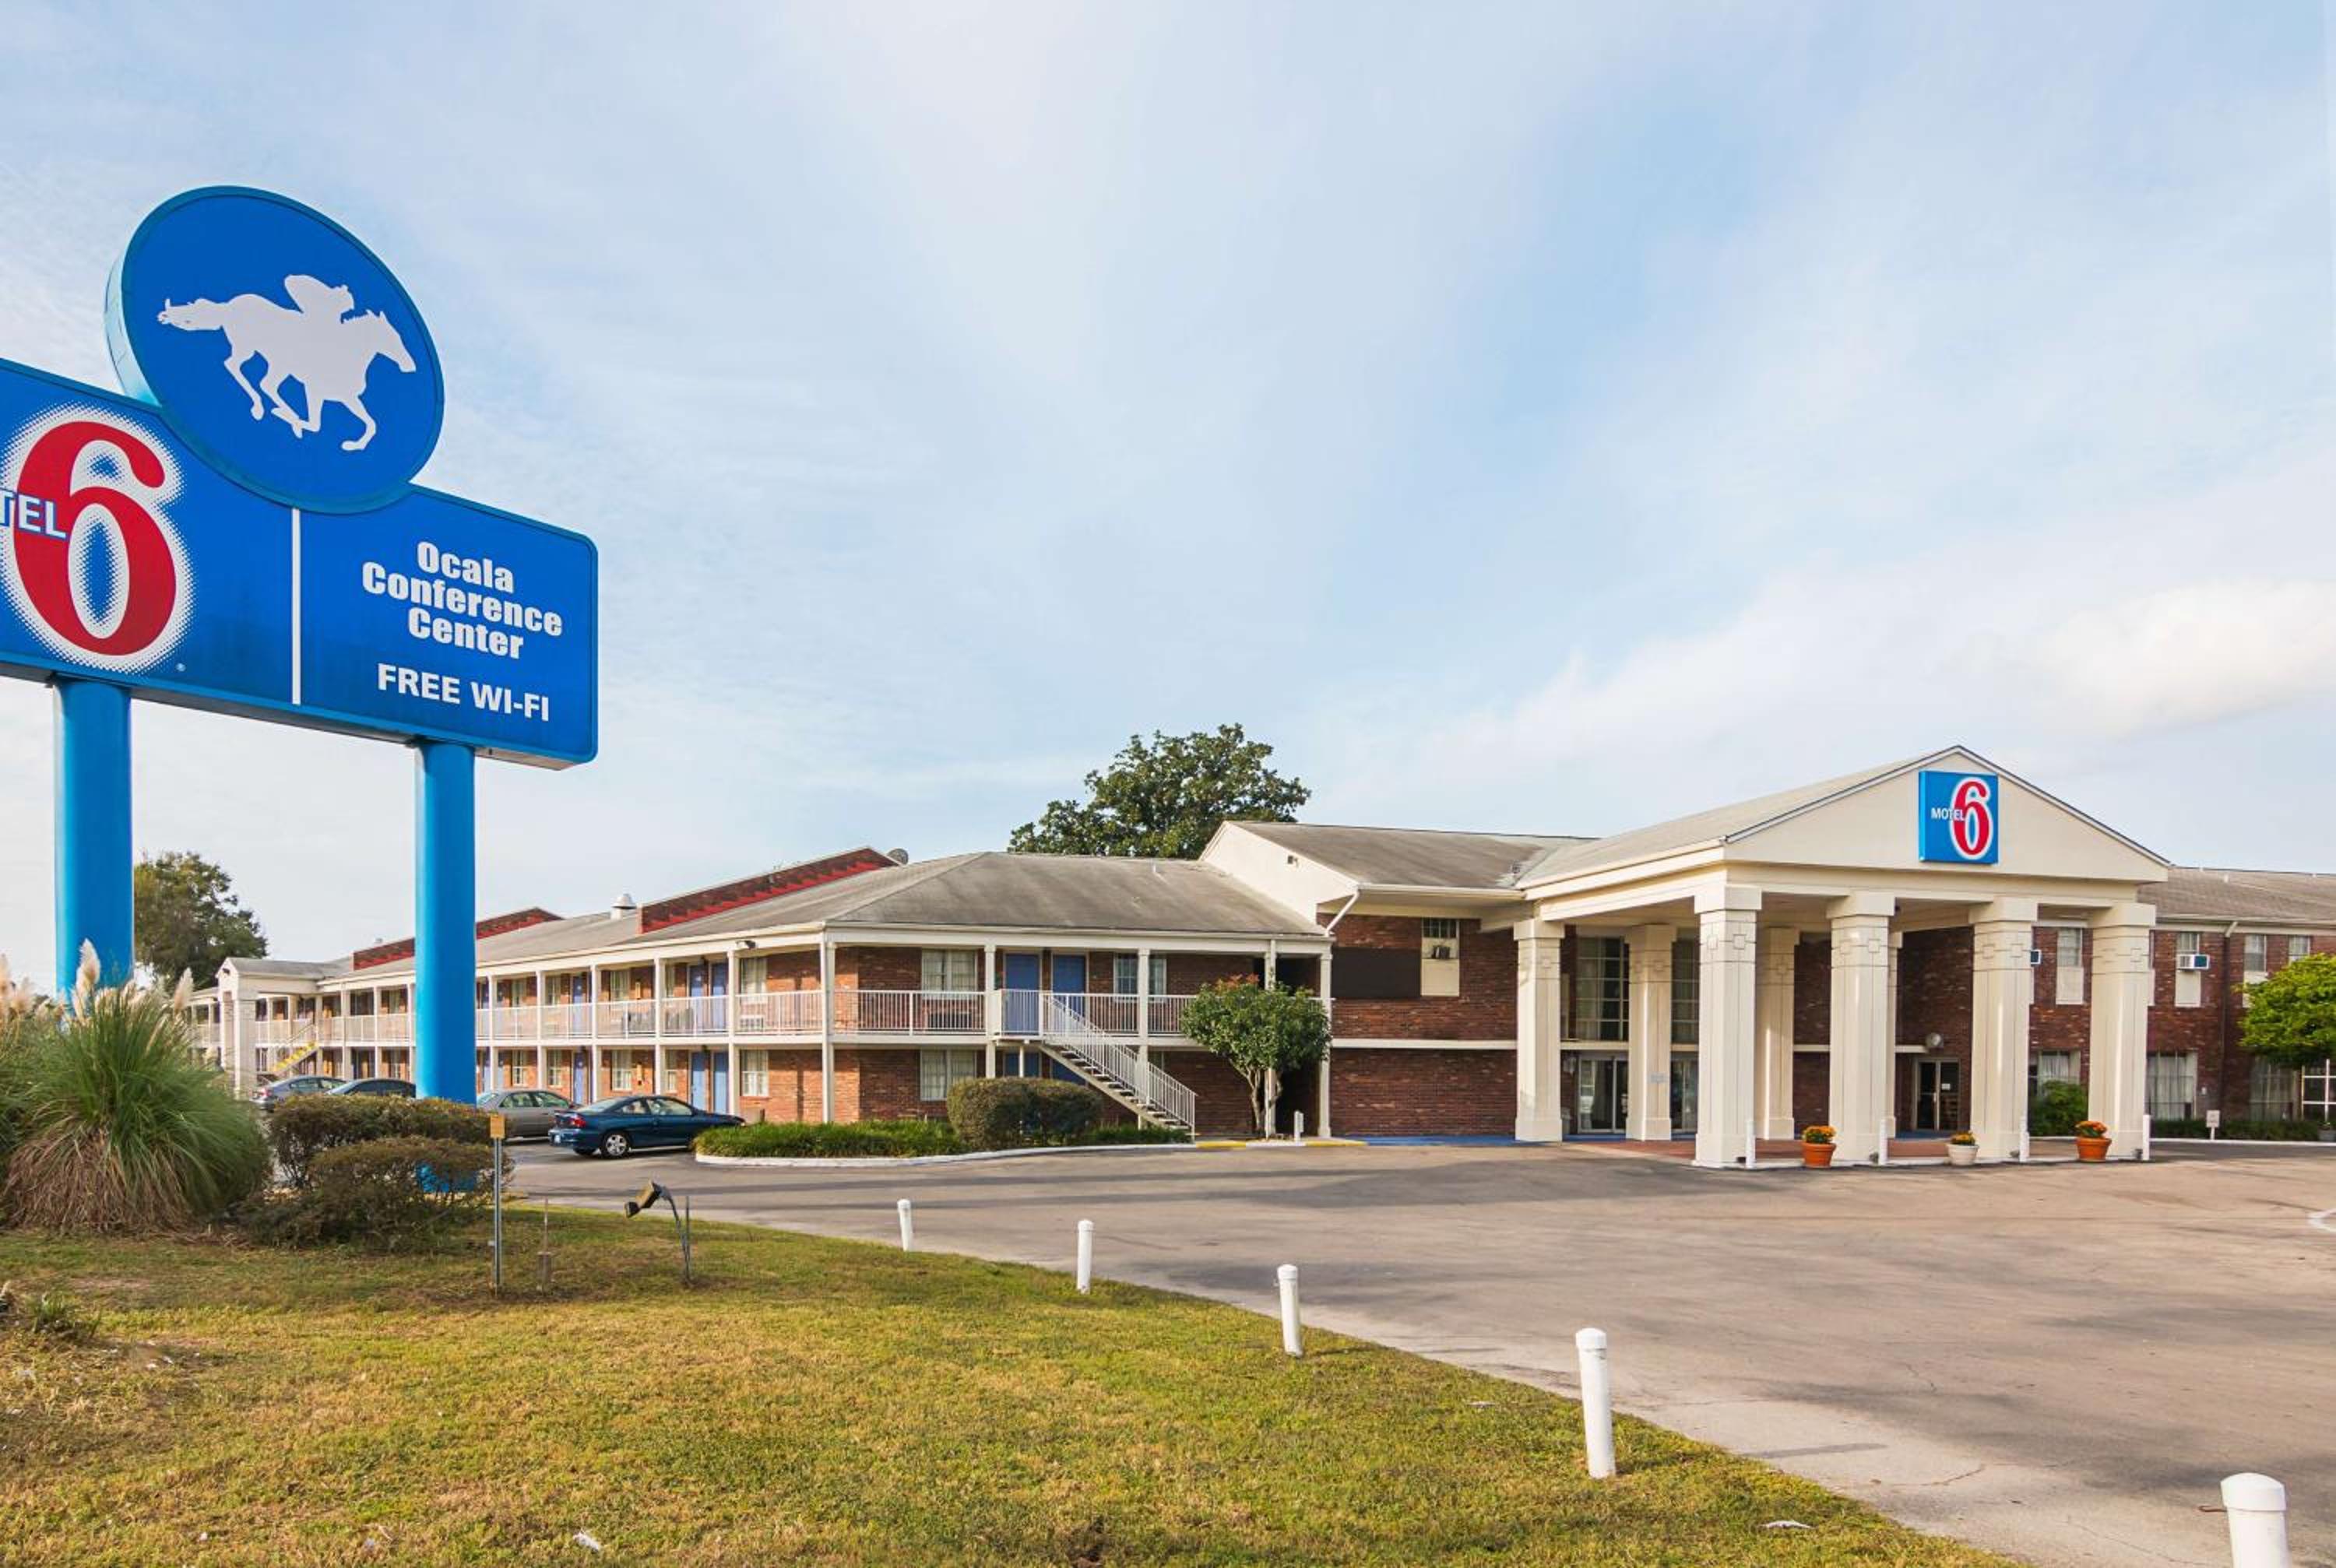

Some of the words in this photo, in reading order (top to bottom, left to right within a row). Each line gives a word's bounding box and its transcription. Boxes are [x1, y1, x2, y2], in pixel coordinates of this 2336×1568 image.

[14, 420, 178, 656] 6
[417, 541, 515, 594] Ocala
[361, 561, 563, 637] Conference
[407, 606, 524, 660] Center
[377, 663, 461, 705] FREE
[470, 680, 550, 722] WI-FI
[1930, 807, 1965, 821] MOTEL
[1951, 780, 1990, 856] 6
